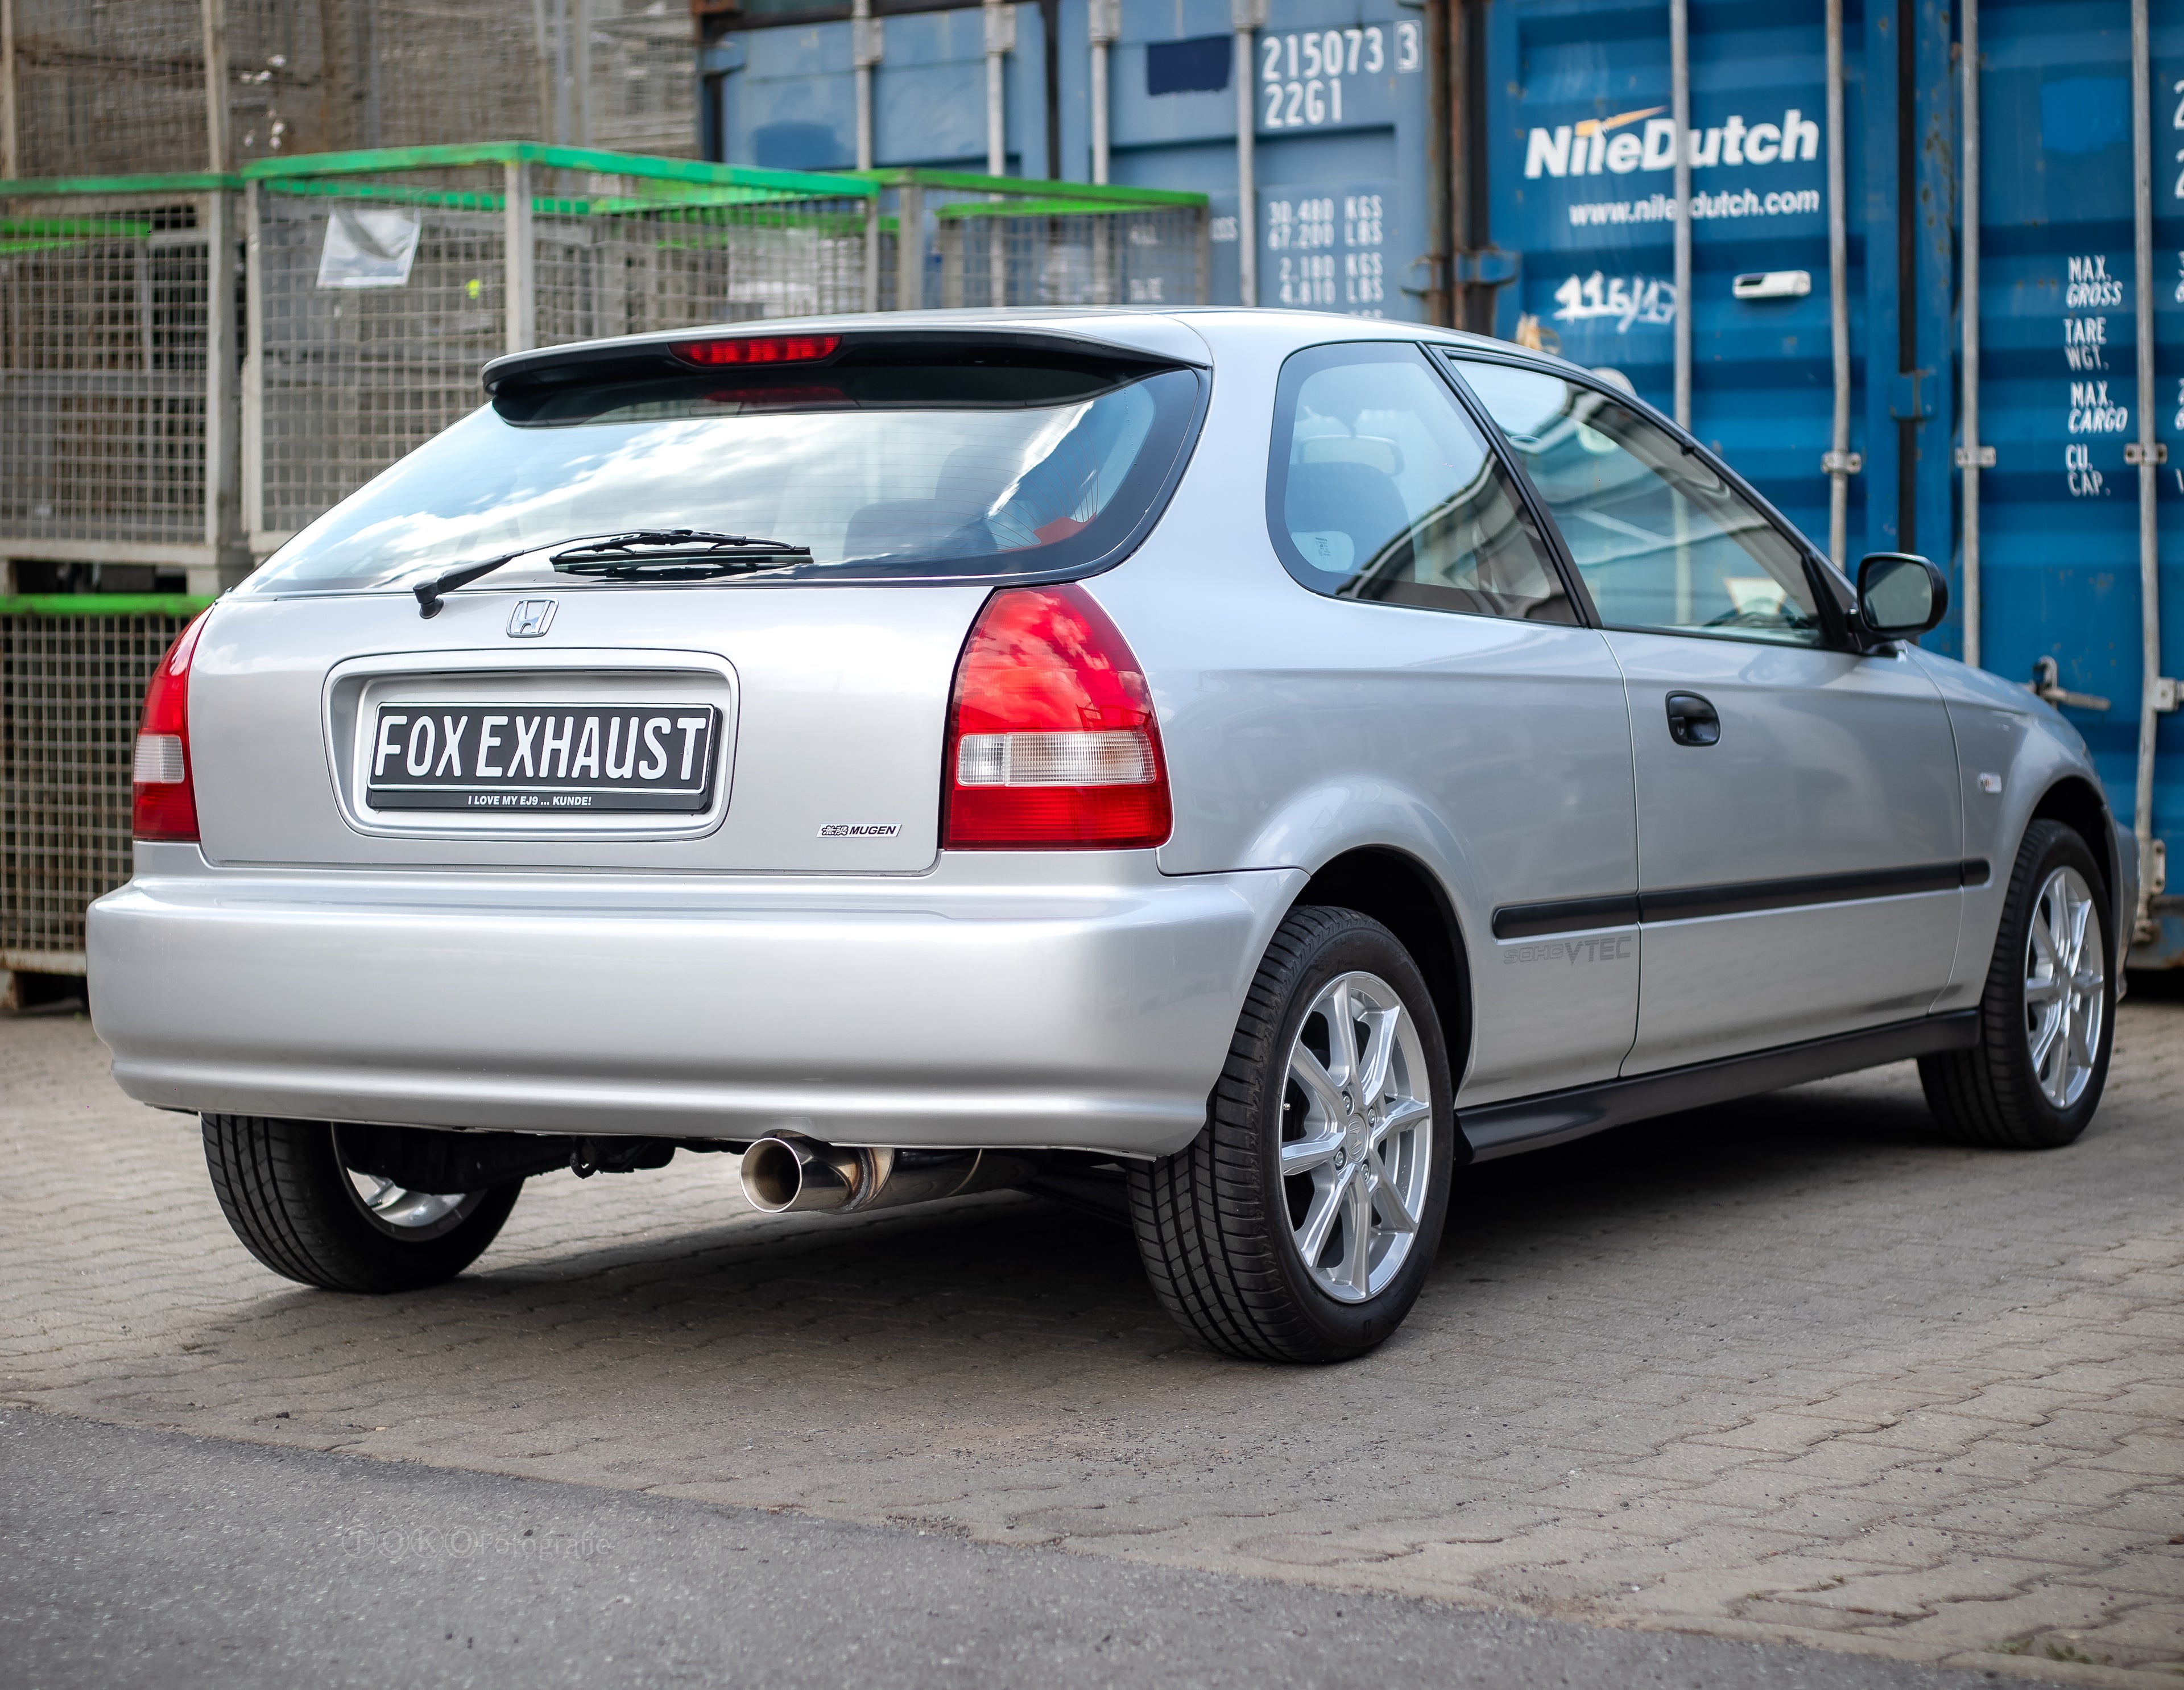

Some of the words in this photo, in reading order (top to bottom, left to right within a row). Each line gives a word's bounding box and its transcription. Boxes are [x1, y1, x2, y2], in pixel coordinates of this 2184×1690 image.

[1261, 26, 1385, 82] 215073
[1397, 22, 1420, 71] 3
[1264, 78, 1343, 129] 22G1
[1524, 108, 1819, 180] NileDutch
[1344, 195, 1384, 222] KGS
[1344, 219, 1384, 247] LBS
[1345, 252, 1384, 279] KGS
[2067, 254, 2112, 283] MAX.
[1346, 276, 1384, 304] LBS
[2065, 280, 2124, 308] GROSS
[2062, 316, 2107, 346] TARE
[2064, 344, 2110, 372] WGT.
[2070, 380, 2114, 409] MAX.
[2067, 406, 2128, 435] CARGO
[2065, 443, 2093, 472] CU.
[2067, 470, 2111, 498] CAP.
[374, 714, 469, 778] FOX
[475, 715, 707, 781] EXHAUST
[468, 795, 473, 805] I
[474, 795, 500, 805] LOVE
[502, 795, 519, 806] MY
[519, 796, 539, 806] EJ9
[552, 796, 593, 806] KUNDE!
[849, 826, 897, 835] MUGEN
[1564, 936, 1632, 967] VTEC
